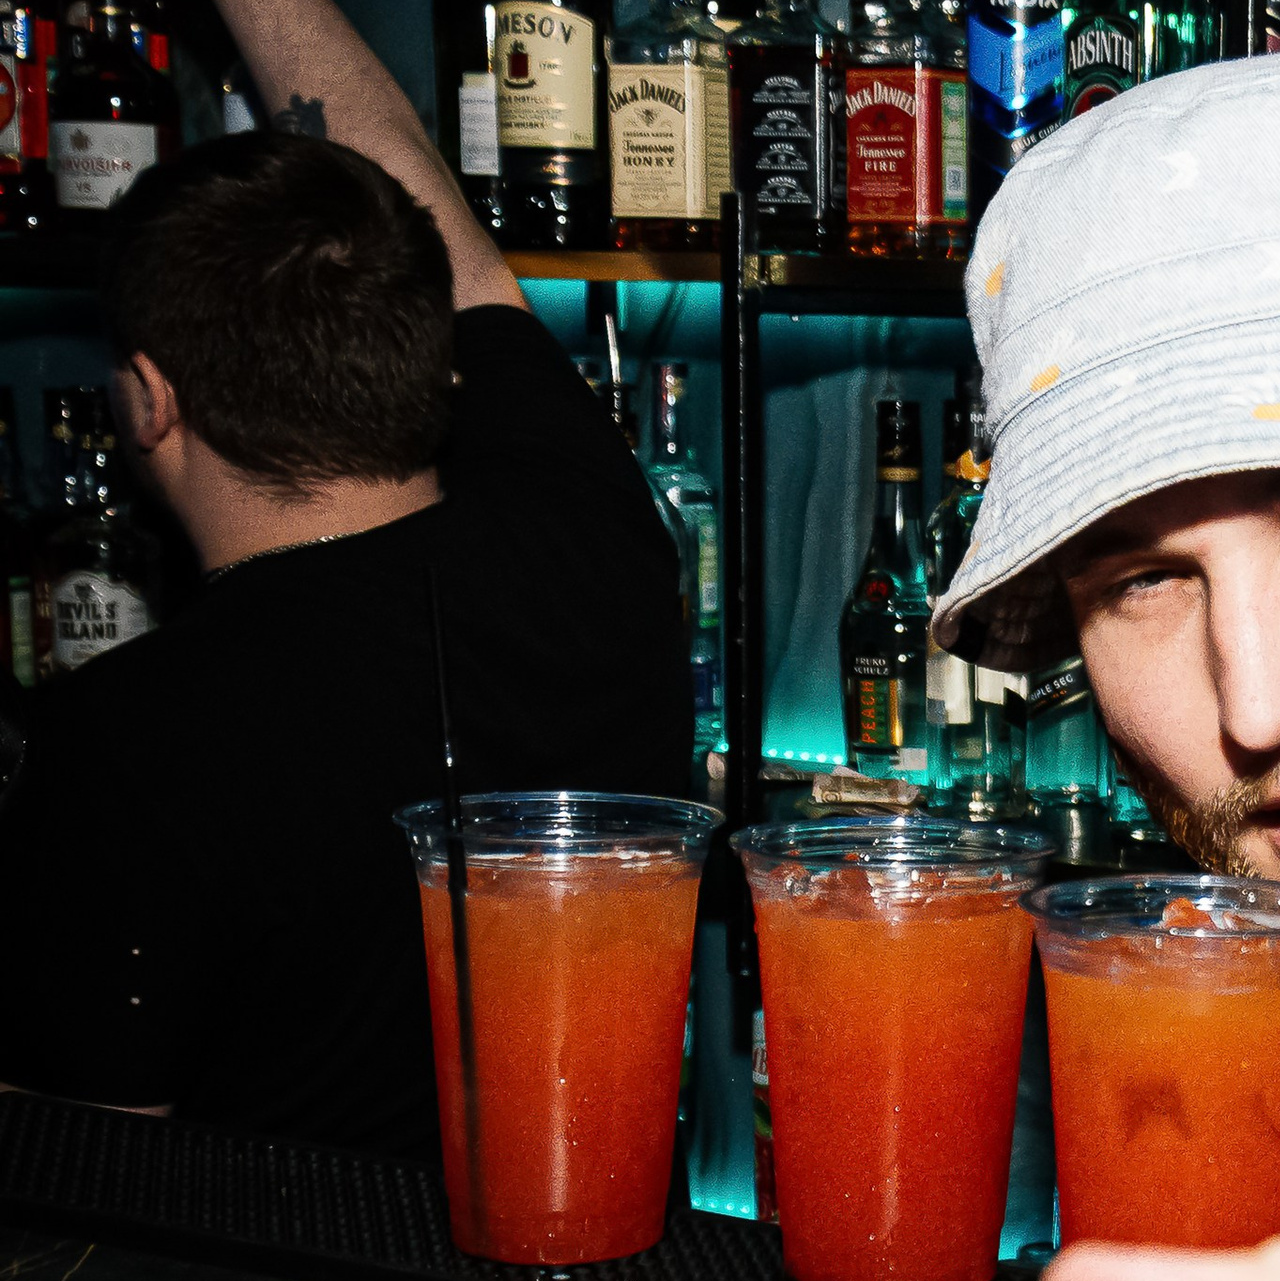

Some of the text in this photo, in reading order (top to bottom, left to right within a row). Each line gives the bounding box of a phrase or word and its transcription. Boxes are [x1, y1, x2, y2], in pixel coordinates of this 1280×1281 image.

[500, 12, 574, 46] MESON
[1068, 30, 1134, 75] ABSINTH
[608, 83, 639, 114] JACK
[845, 86, 873, 119] JACK
[864, 161, 897, 173] FIRE
[1052, 673, 1075, 689] SEC
[861, 679, 877, 745] PEACH
